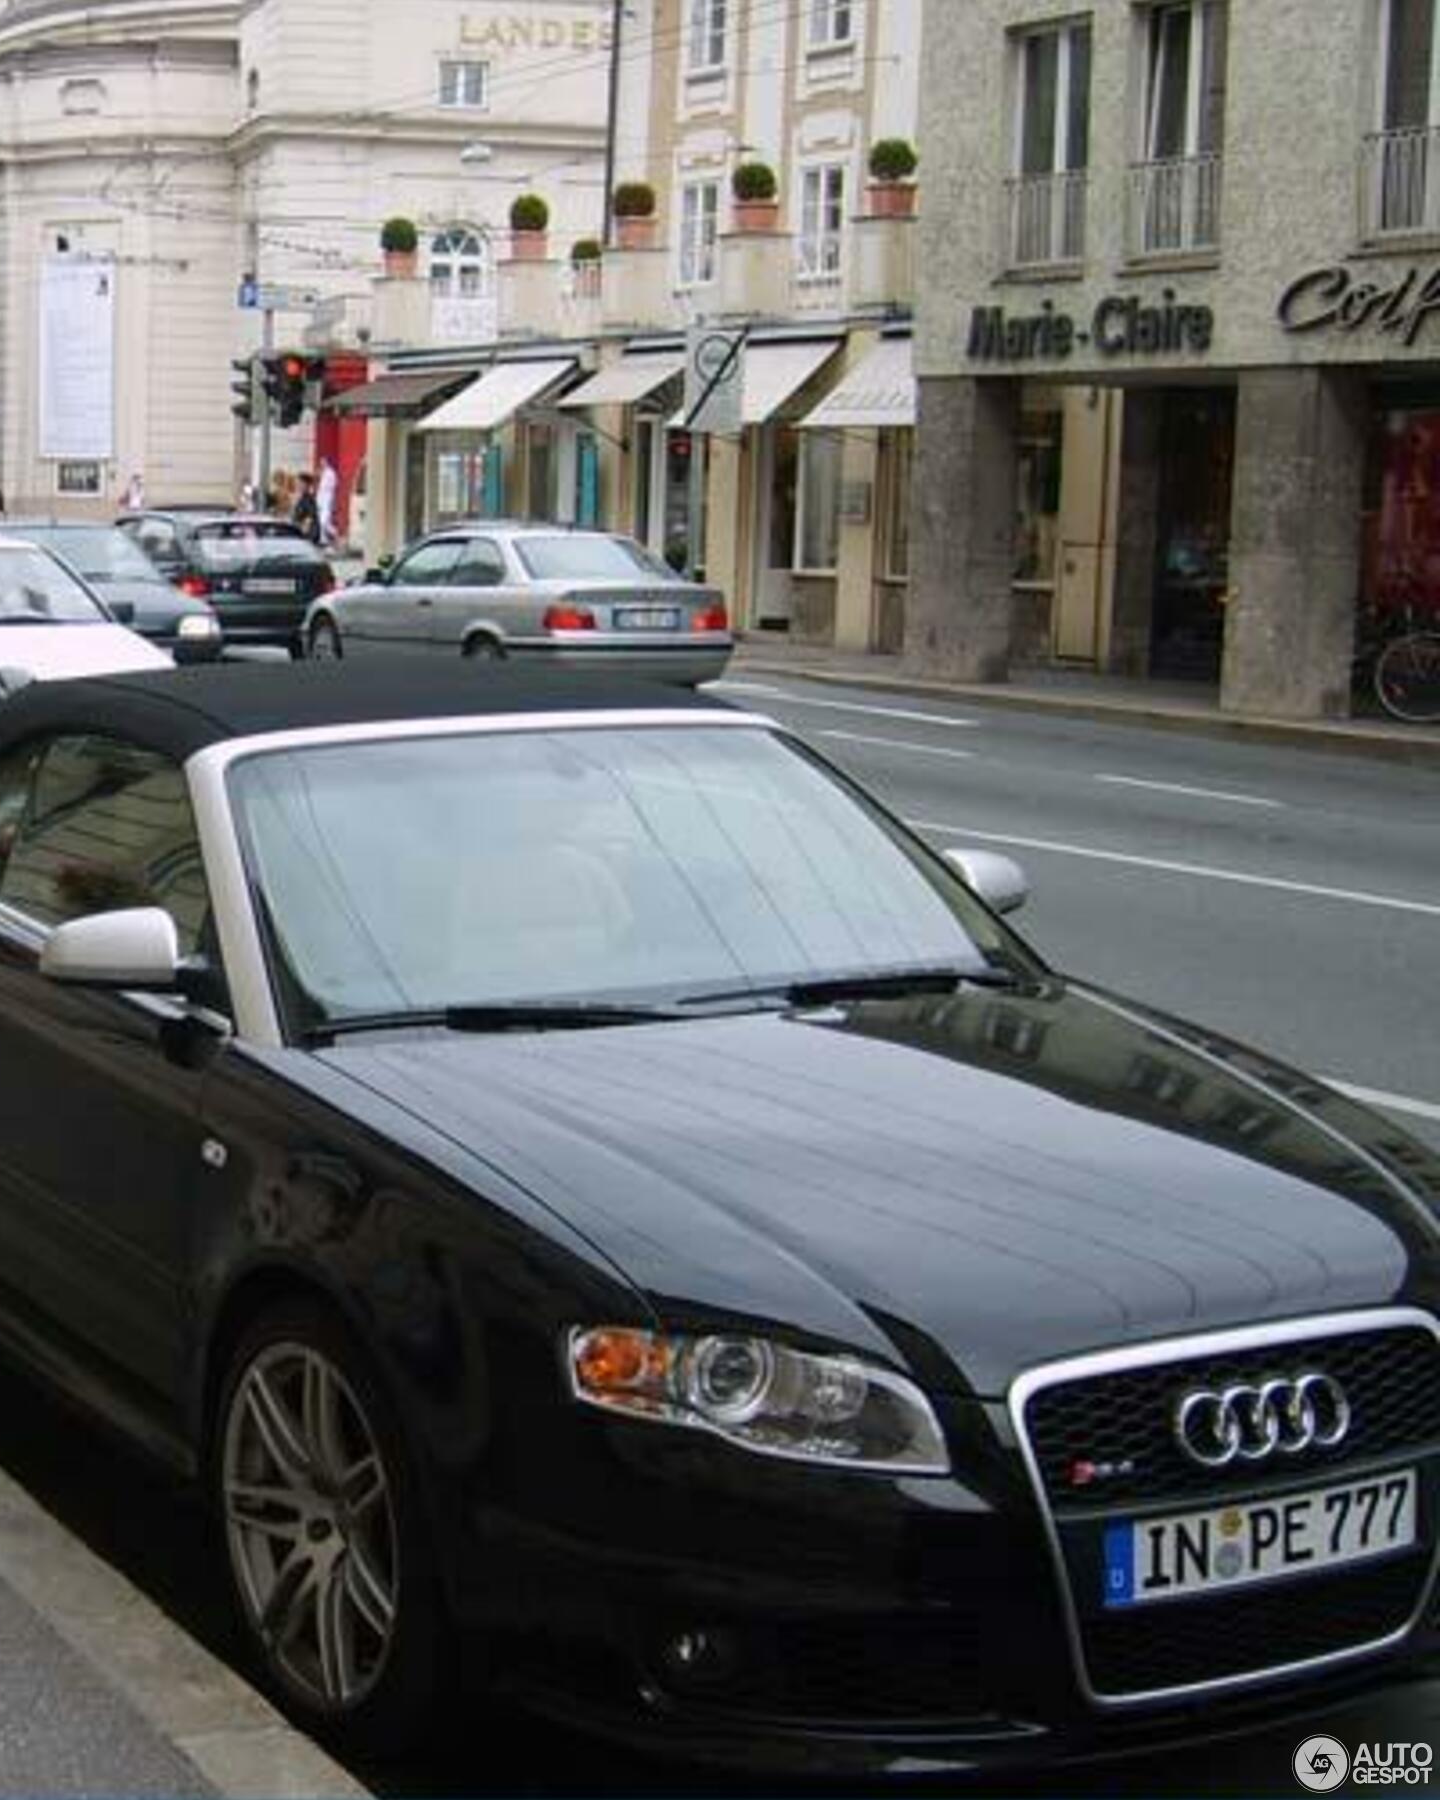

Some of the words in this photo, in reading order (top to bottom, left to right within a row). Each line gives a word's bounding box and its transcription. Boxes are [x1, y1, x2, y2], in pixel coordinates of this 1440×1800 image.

[1143, 1519, 1209, 1588] IN
[1248, 1500, 1312, 1570] PE
[1324, 1477, 1409, 1554] 777
